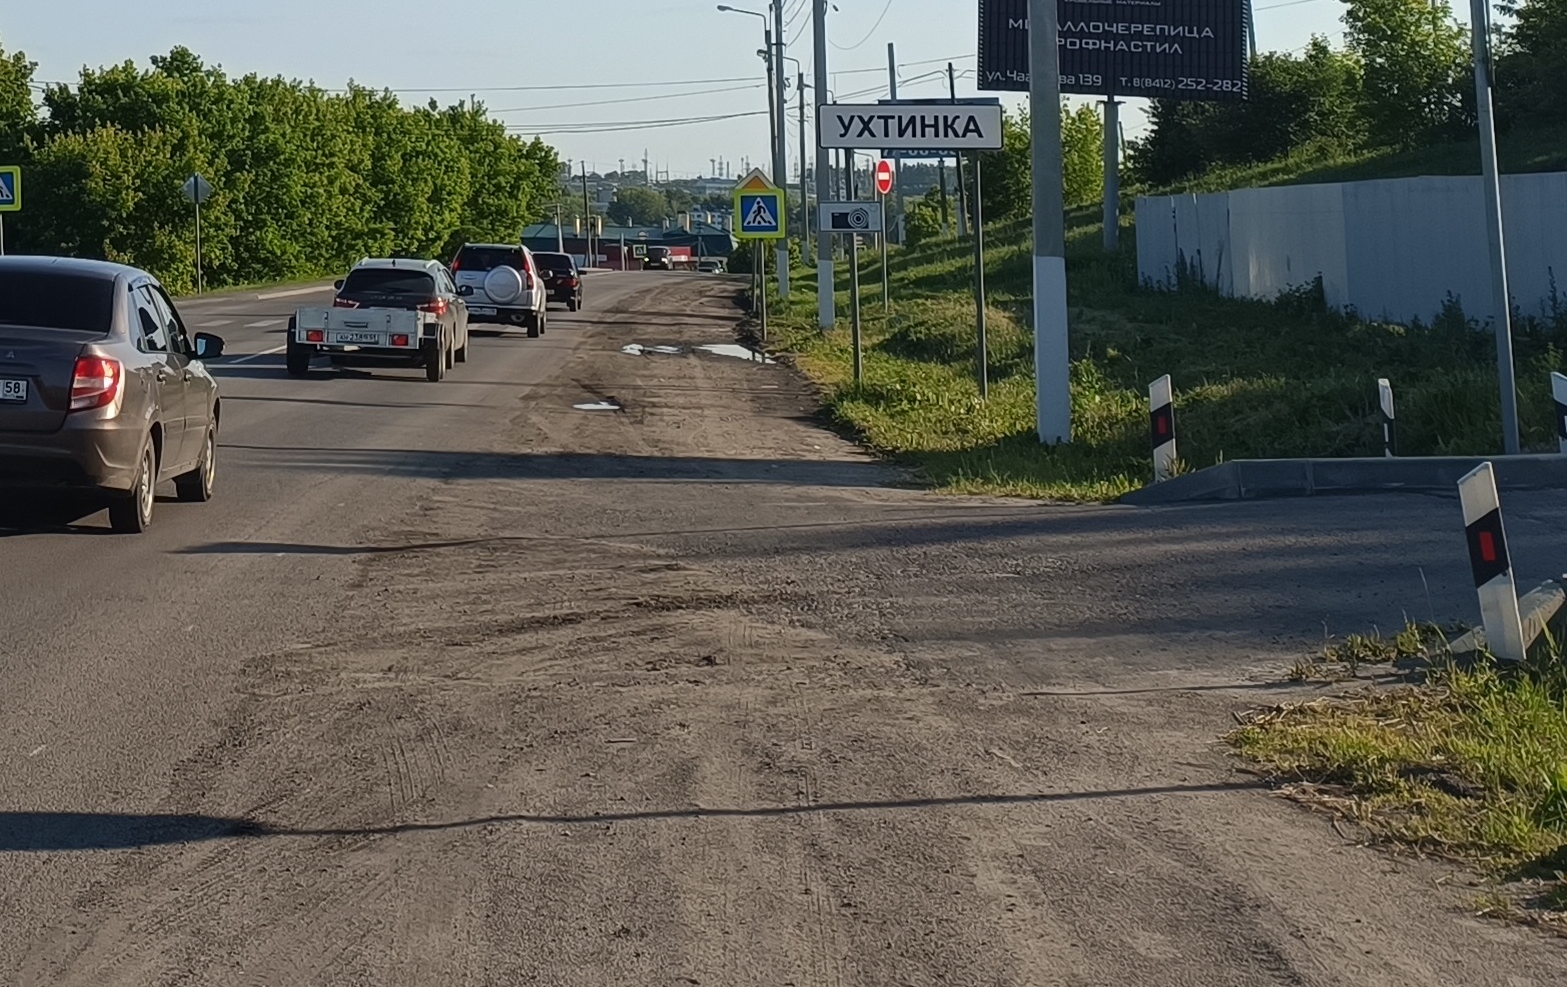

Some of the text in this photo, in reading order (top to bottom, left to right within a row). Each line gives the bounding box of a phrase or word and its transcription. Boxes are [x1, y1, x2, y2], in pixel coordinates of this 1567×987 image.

[1008, 18, 1215, 39] МЛЛОЧЕРЕПИЦА
[1056, 38, 1183, 55] РОФНАСТИЛ
[1078, 74, 1102, 86] 139
[1177, 77, 1242, 92] 252-282
[836, 115, 984, 138] УХТИНКА
